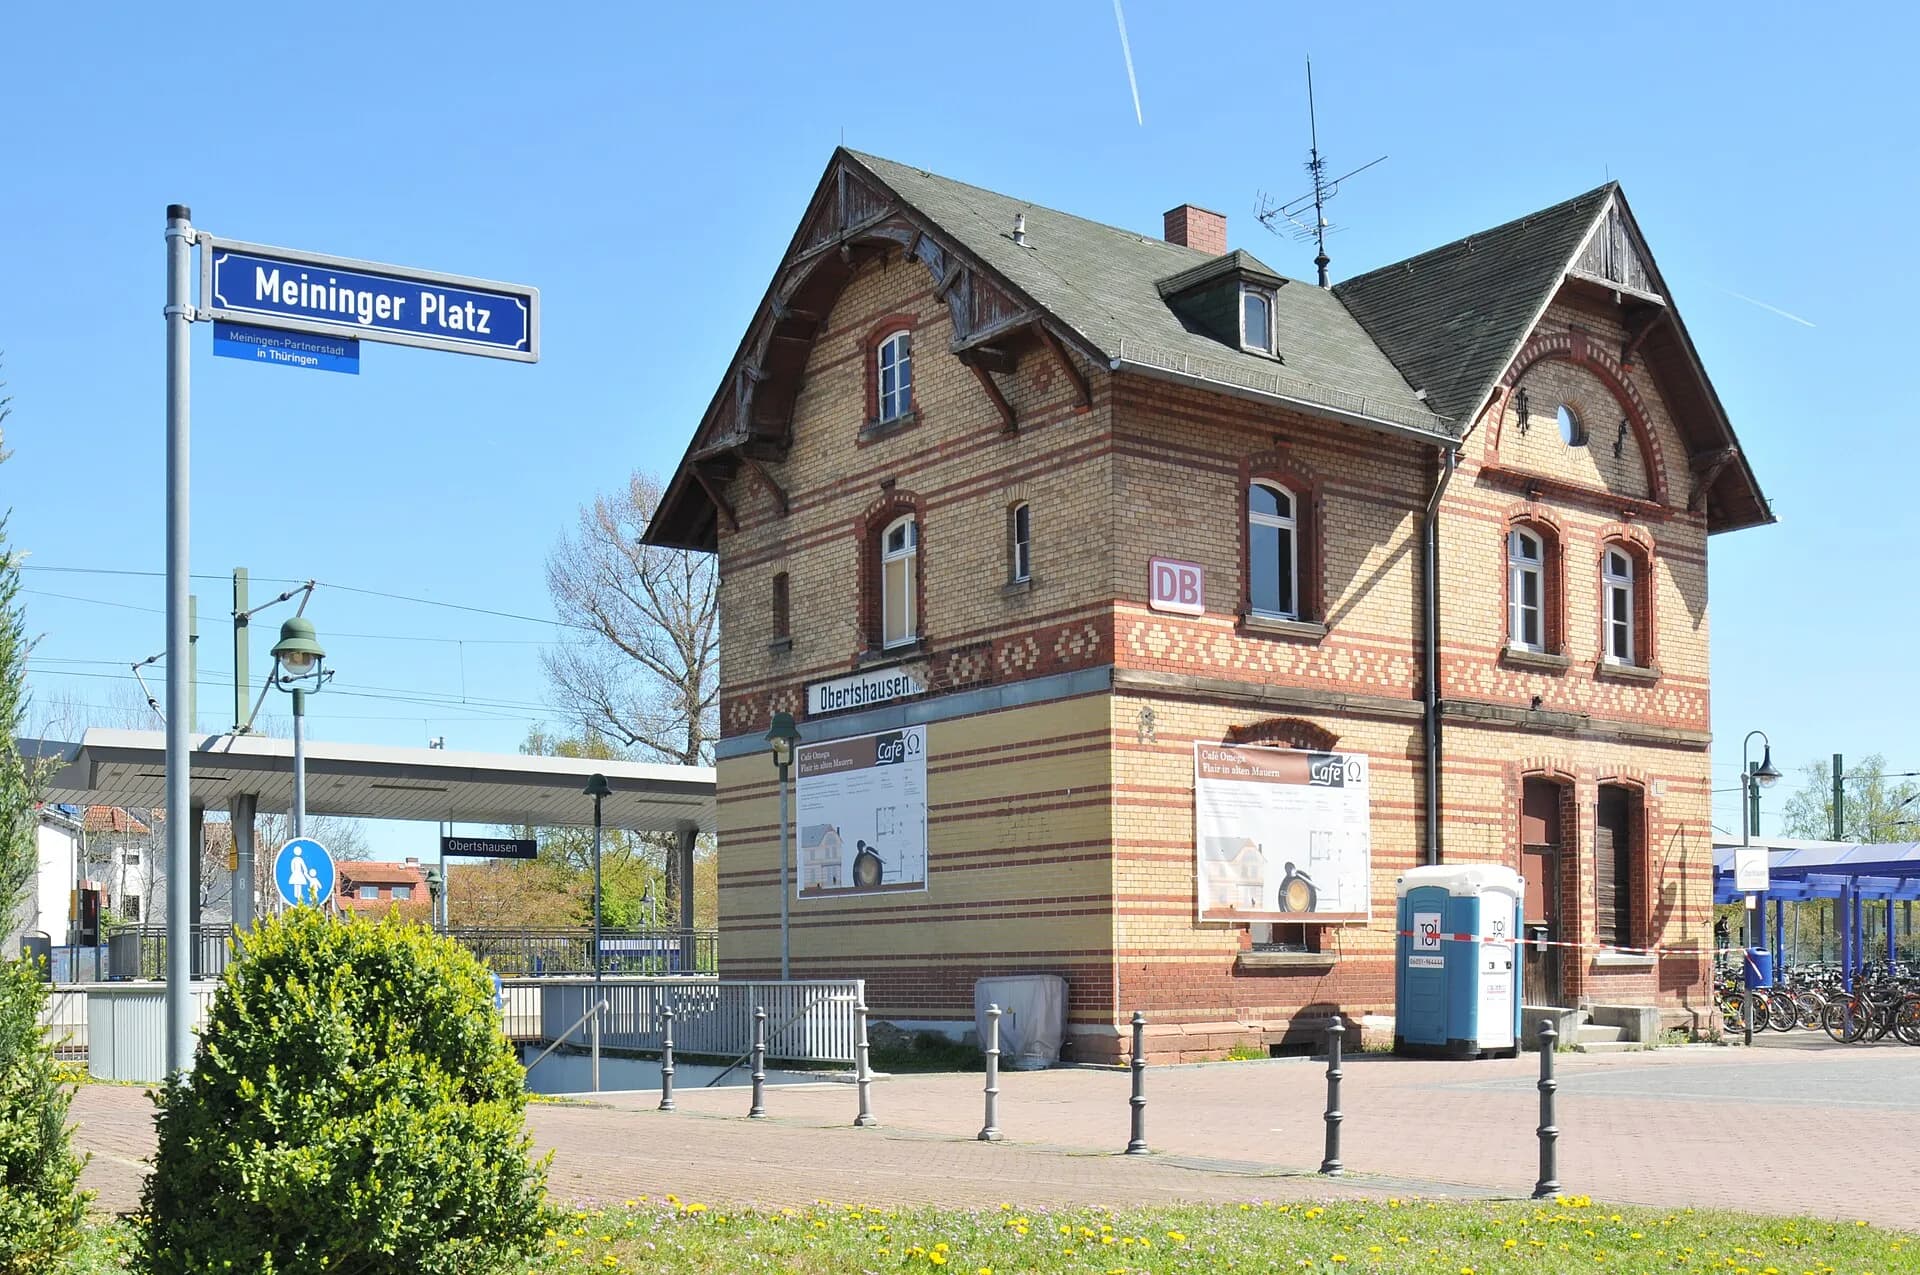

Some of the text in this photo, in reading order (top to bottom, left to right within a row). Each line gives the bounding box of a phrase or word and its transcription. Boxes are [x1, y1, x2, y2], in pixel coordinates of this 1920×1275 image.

[255, 266, 491, 334] Meininger Platz
[229, 331, 345, 356] Meiningen-Partnerstadt
[256, 347, 319, 366] in Thüringen
[1157, 565, 1198, 605] DB
[820, 675, 910, 710] Obertshausen
[876, 735, 906, 765] Café
[1202, 750, 1246, 764] Café Omega
[1202, 763, 1280, 777] Flair in alten Mauern
[1310, 760, 1345, 786] Café
[448, 840, 518, 853] Obertshausen
